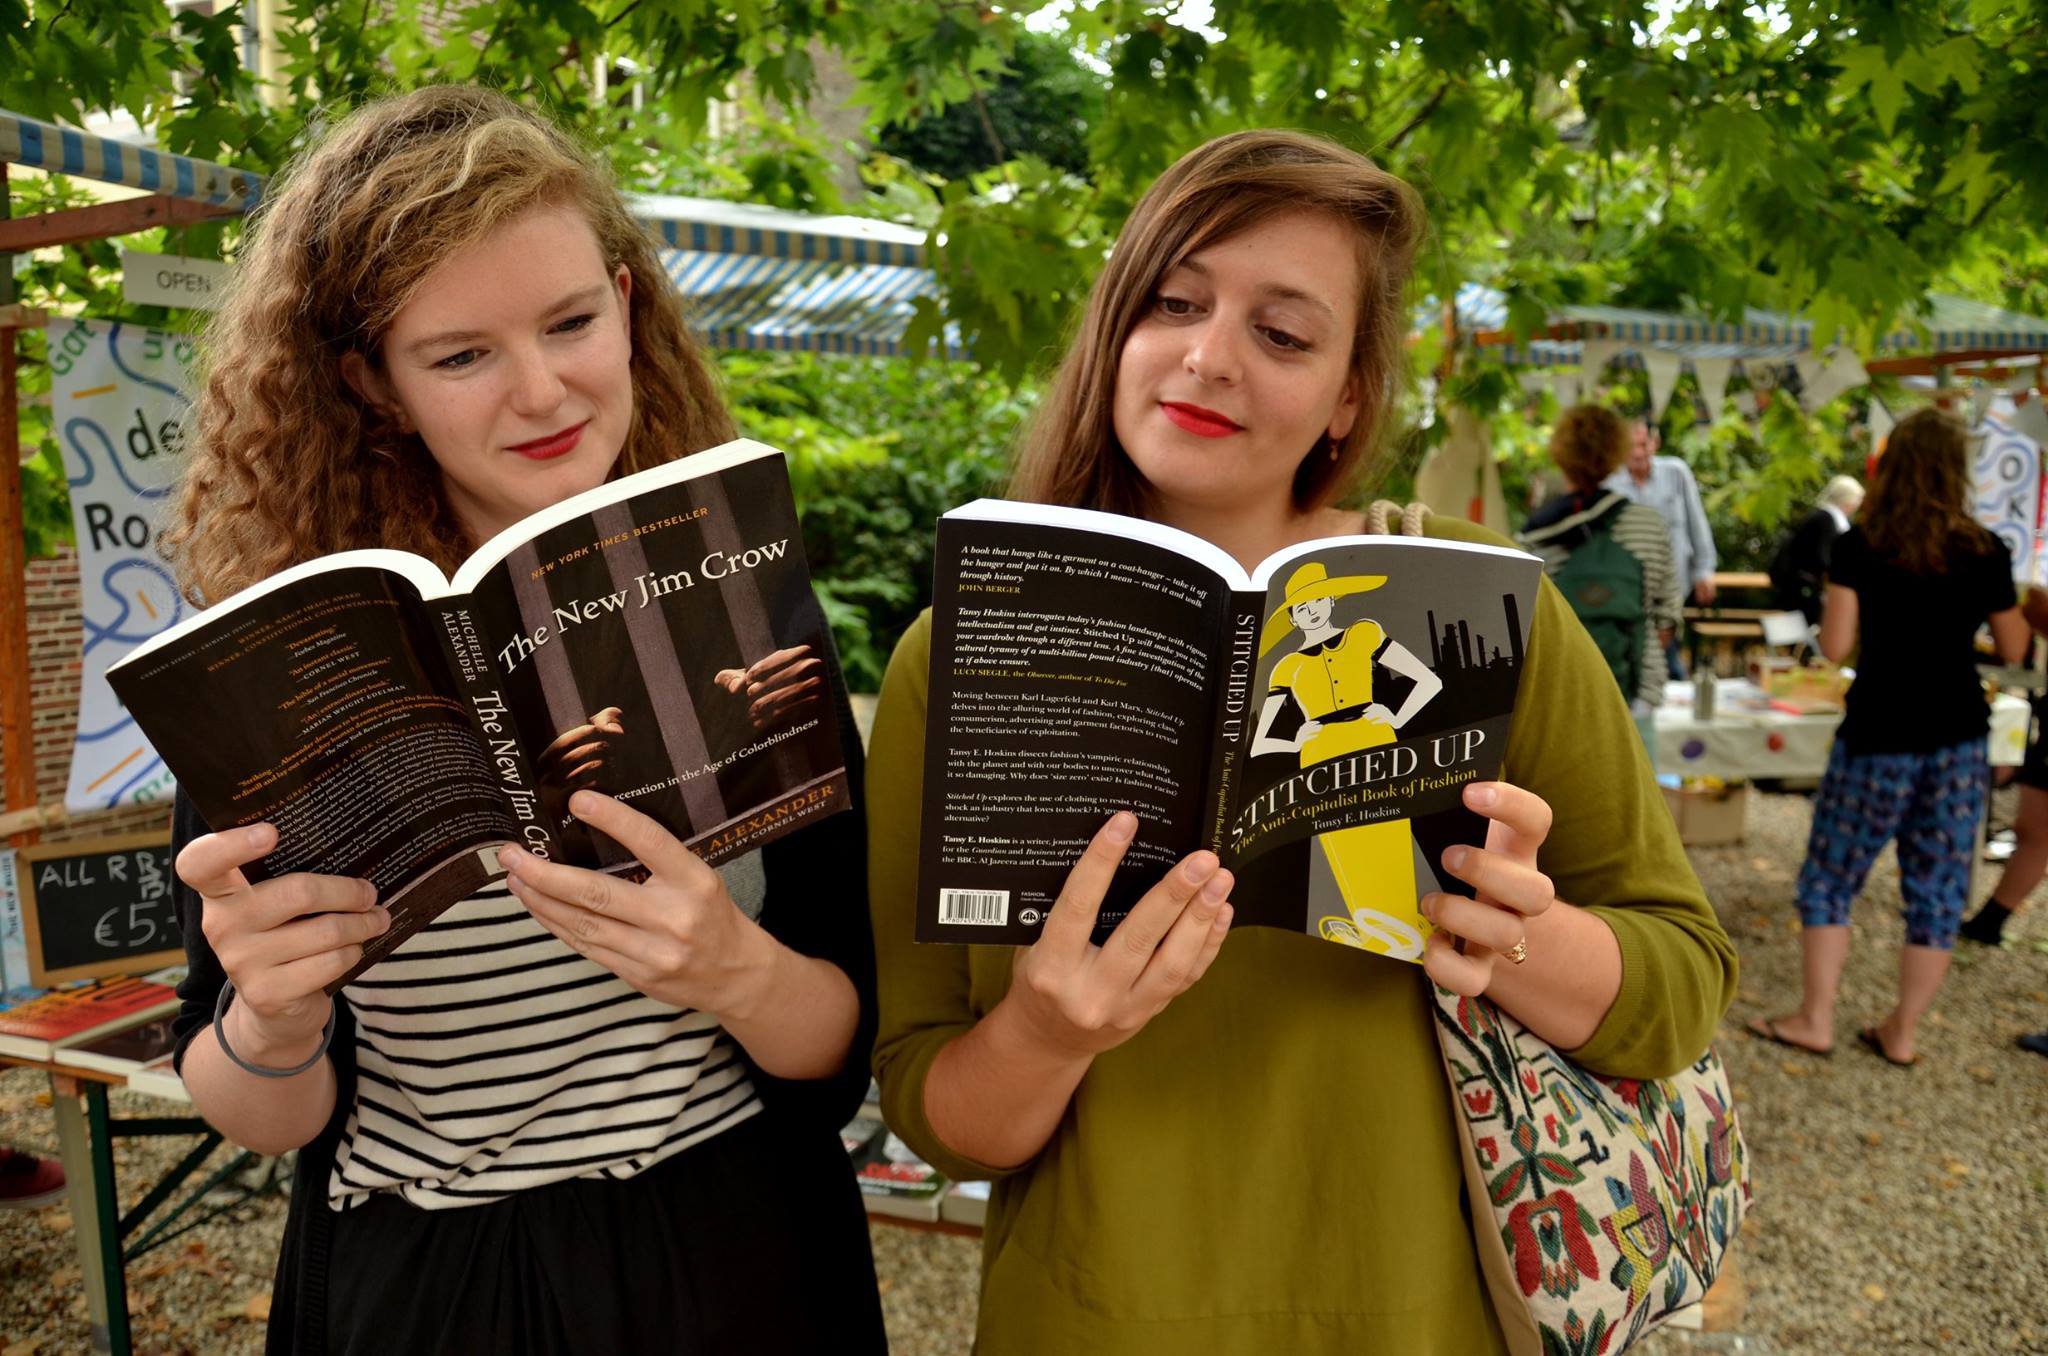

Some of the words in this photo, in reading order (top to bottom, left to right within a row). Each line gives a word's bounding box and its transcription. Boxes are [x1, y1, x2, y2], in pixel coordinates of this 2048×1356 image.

[157, 270, 211, 292] OPEN
[530, 561, 555, 581] NEW
[558, 546, 589, 564] YORK
[594, 531, 630, 551] TIMES
[633, 507, 711, 537] BESTSELLER
[958, 583, 983, 592] JOHN
[985, 585, 1020, 594] BERGER
[959, 570, 992, 581] through
[993, 572, 1024, 584] history.
[960, 545, 968, 553] A
[970, 545, 990, 555] book
[991, 547, 1010, 556] that
[1010, 548, 1035, 559] hangs
[1037, 550, 1053, 559] like
[1061, 555, 1097, 565] garment
[1118, 563, 1165, 580] coat-hanger
[1172, 577, 1189, 589] take
[1189, 584, 1196, 592] it
[1196, 589, 1208, 600] off
[960, 558, 974, 566] the
[975, 558, 1005, 570] hanger
[1006, 561, 1023, 569] and
[1023, 562, 1039, 572] put
[1040, 563, 1048, 571] it
[1064, 565, 1076, 576] By
[1077, 568, 1102, 578] which
[1104, 571, 1109, 579] I
[1110, 574, 1133, 583] mean
[1141, 581, 1161, 591] read
[1161, 585, 1168, 593] it
[1168, 590, 1185, 599] and
[1184, 595, 1202, 608] walk
[498, 624, 549, 674] The
[552, 590, 629, 632] New
[635, 570, 694, 608] Jim
[700, 538, 789, 580] Crow
[441, 611, 477, 683] ALEXANDER
[457, 609, 488, 673] MICHELLE
[955, 633, 975, 641] your
[975, 633, 1015, 641] wardrobe
[1016, 634, 1048, 645] through
[1057, 636, 1092, 647] different
[1093, 640, 1111, 650] lens.
[1112, 644, 1120, 652] A
[1119, 645, 1137, 655] fine
[1138, 648, 1186, 670] investigation
[1186, 667, 1195, 676] of
[1194, 671, 1205, 681] the
[956, 619, 1015, 629] intellectualism
[1033, 624, 1048, 633] gut
[1049, 624, 1081, 634] instinct.
[1082, 627, 1119, 640] Stitched
[1121, 633, 1135, 645] Up
[1136, 638, 1153, 647] will
[1153, 643, 1174, 654] make
[1173, 650, 1188, 661] you
[1189, 657, 1205, 669] view
[958, 607, 981, 618] Tansy
[983, 608, 1016, 617] Hoskins
[1017, 610, 1065, 621] interrogates
[1066, 615, 1095, 626] today’s
[1094, 618, 1127, 629] fashion
[1127, 624, 1167, 640] landscape
[1168, 636, 1185, 647] with
[1185, 644, 1207, 660] rigour,
[954, 644, 988, 652] cultural
[988, 645, 1019, 656] tyranny
[1020, 646, 1030, 656] of
[1038, 648, 1088, 658] multi-billion
[1088, 652, 1115, 662] pound
[1116, 656, 1149, 671] industry
[1150, 664, 1174, 677] [that]
[1174, 673, 1202, 691] operates
[965, 655, 973, 666] if
[973, 656, 998, 664] above
[1226, 614, 1256, 713] STITCHED
[472, 690, 508, 734] The
[1223, 719, 1242, 742] UP
[488, 739, 522, 786] New
[667, 774, 681, 787] in
[681, 768, 701, 785] the
[703, 760, 724, 777] Age
[724, 751, 736, 764] of
[738, 718, 818, 758] Colorblindness
[500, 789, 536, 821] Jim
[1231, 746, 1418, 848] STITCHED
[1430, 729, 1486, 768] UP
[1234, 832, 1255, 854] The
[1261, 793, 1357, 832] Anti-Capitalist
[1362, 783, 1397, 802] Book
[1400, 780, 1414, 797] of
[1419, 769, 1477, 793] Fashion
[710, 785, 833, 851] ALEXANDER
[735, 836, 748, 847] BY
[751, 815, 795, 839] CORNEL
[797, 800, 826, 817] WEST
[1311, 818, 1341, 830] Tansy
[1345, 812, 1356, 823] E.
[1359, 806, 1400, 821] Hoskins
[523, 825, 550, 861] Cro
[39, 859, 95, 890] ALL
